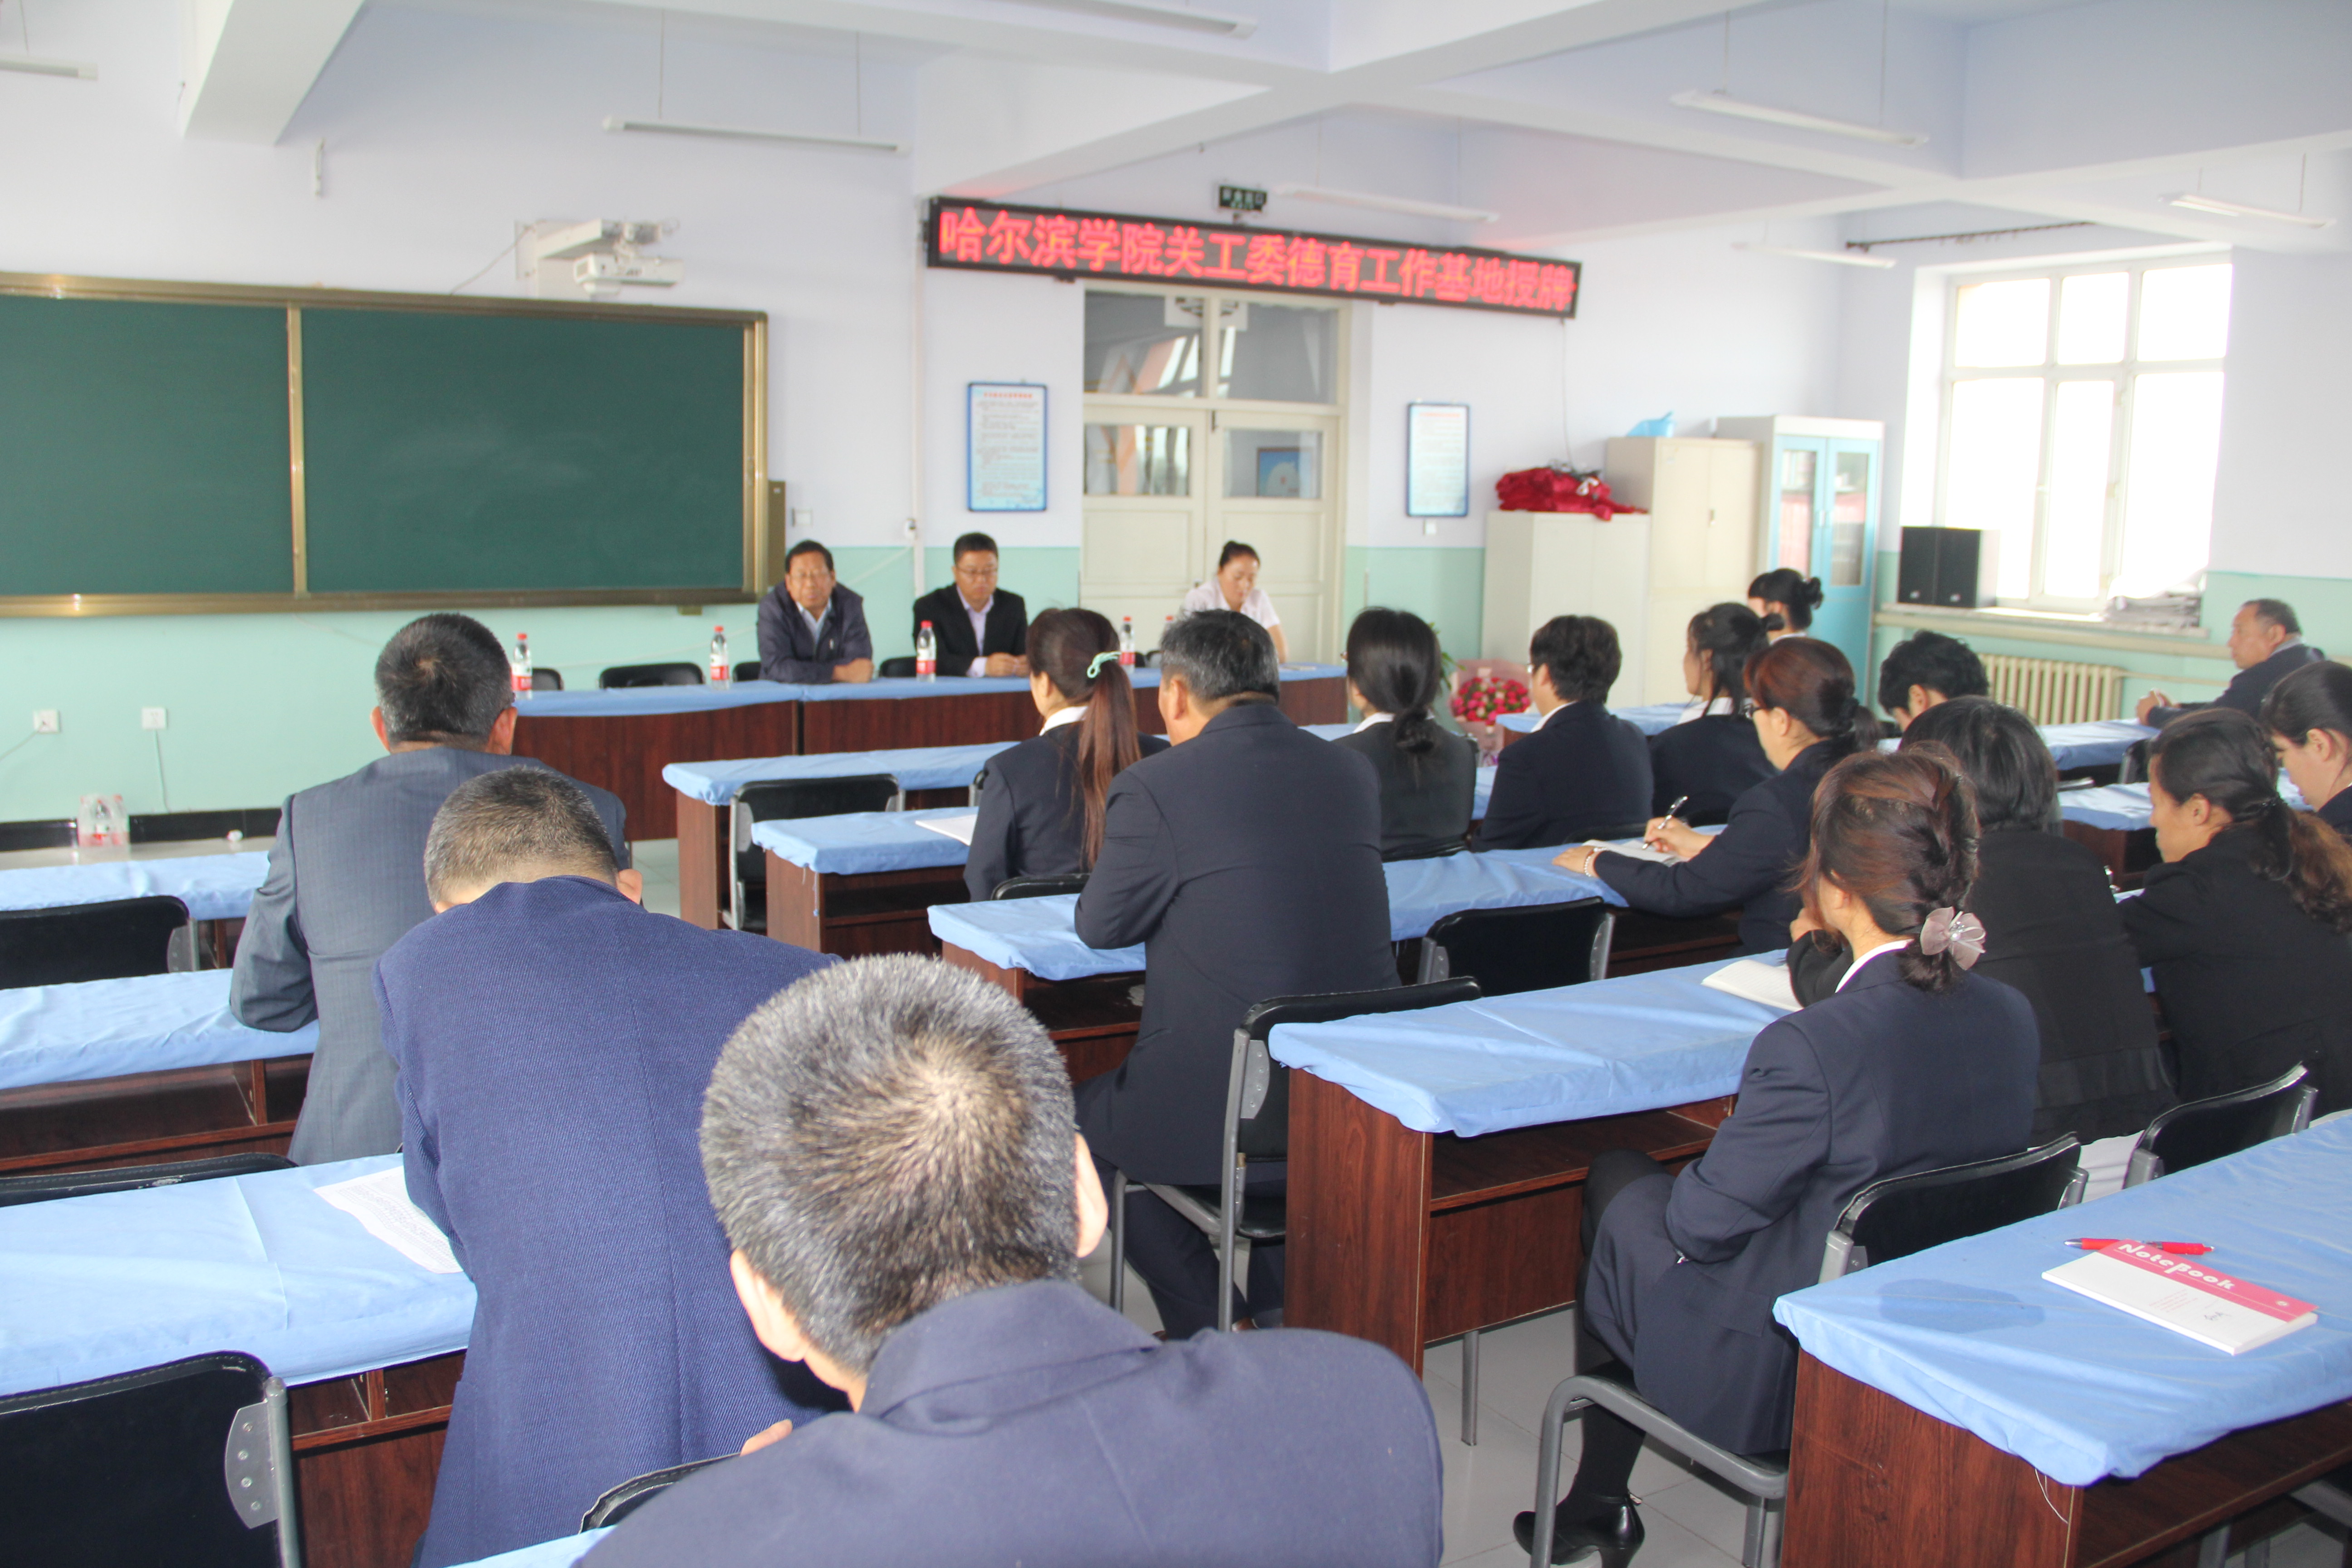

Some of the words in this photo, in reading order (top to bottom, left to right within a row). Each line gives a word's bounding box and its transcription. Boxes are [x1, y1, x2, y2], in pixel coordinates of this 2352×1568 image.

[939, 207, 1574, 311] 哈尔滨学院关工委德育工作基地授牌
